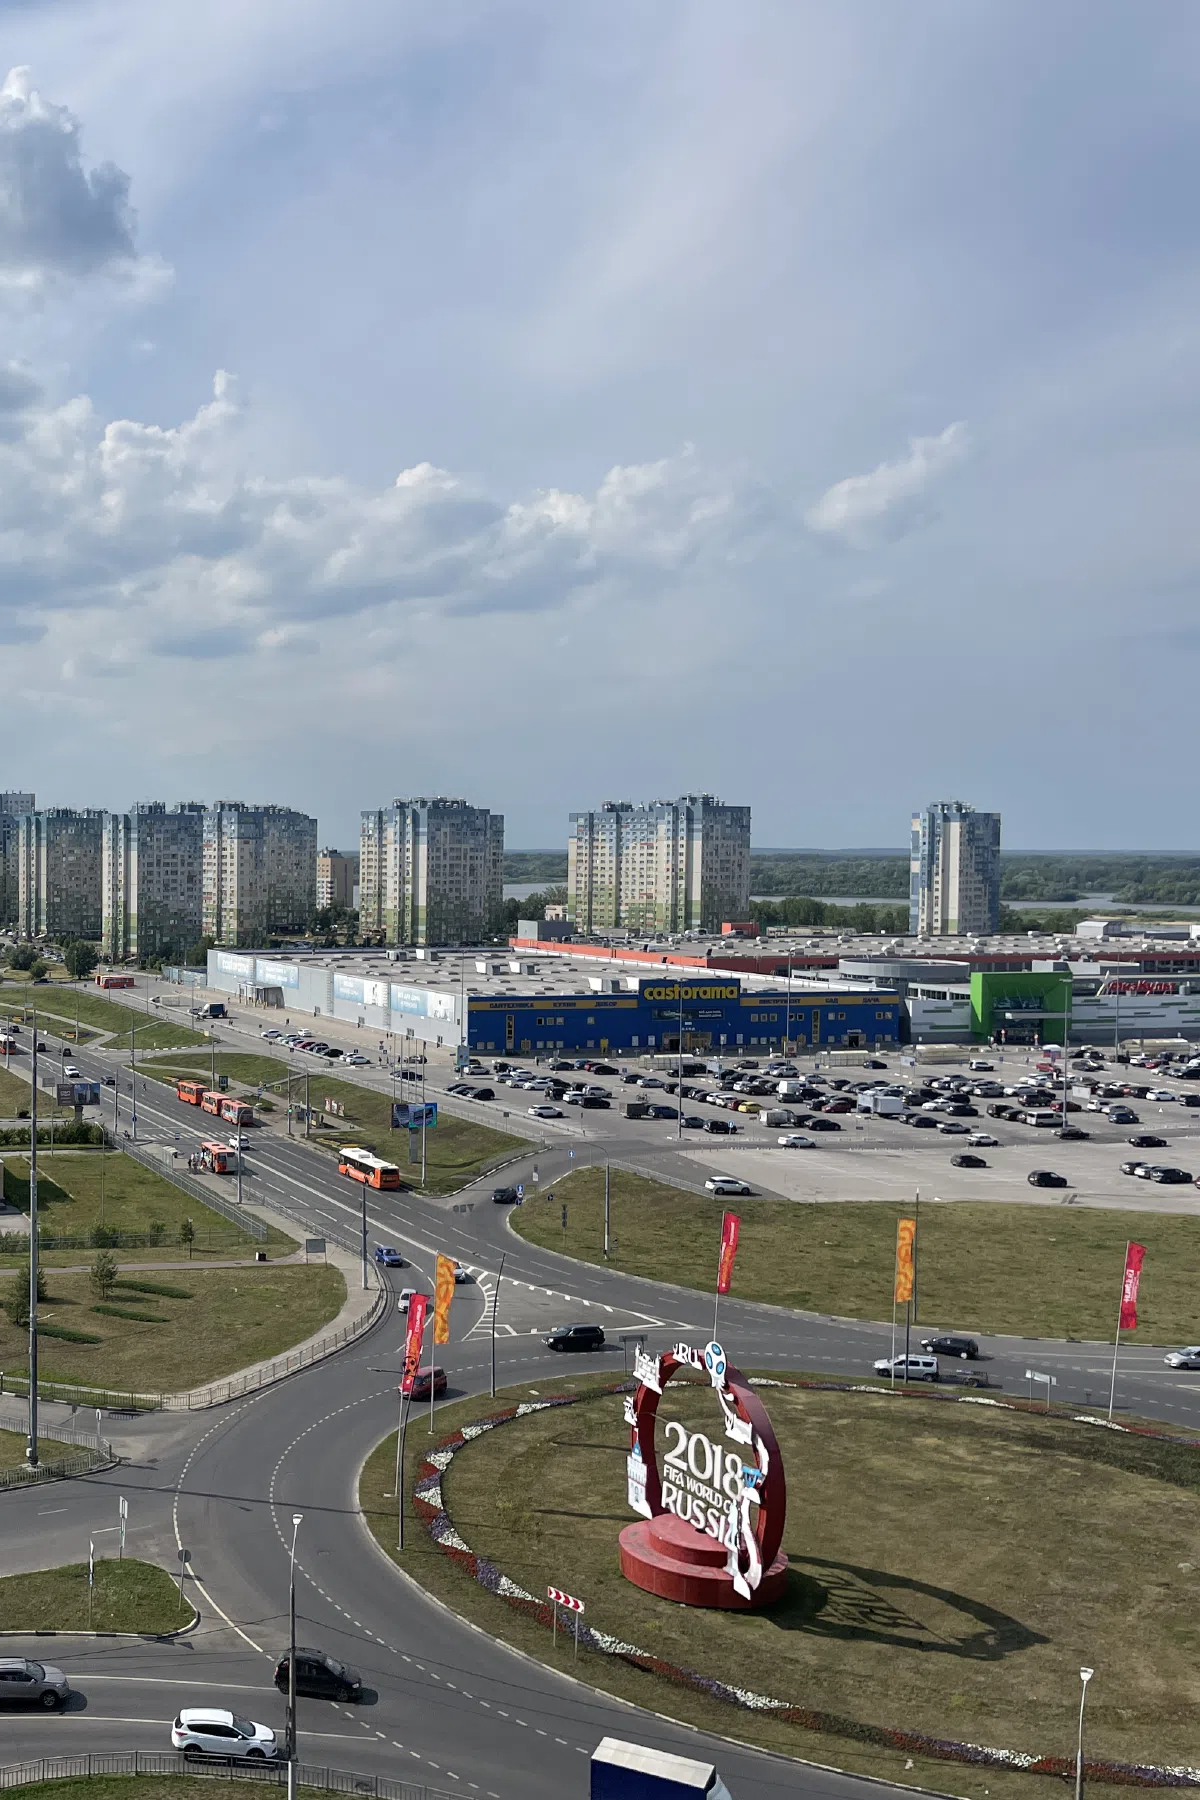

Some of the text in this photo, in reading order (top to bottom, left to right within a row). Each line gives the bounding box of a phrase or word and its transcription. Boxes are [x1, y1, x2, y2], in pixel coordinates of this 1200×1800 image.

[644, 984, 738, 1000] castorama
[664, 1421, 744, 1502] 2018
[663, 1464, 685, 1488] FIFA
[686, 1476, 723, 1509] WORLD
